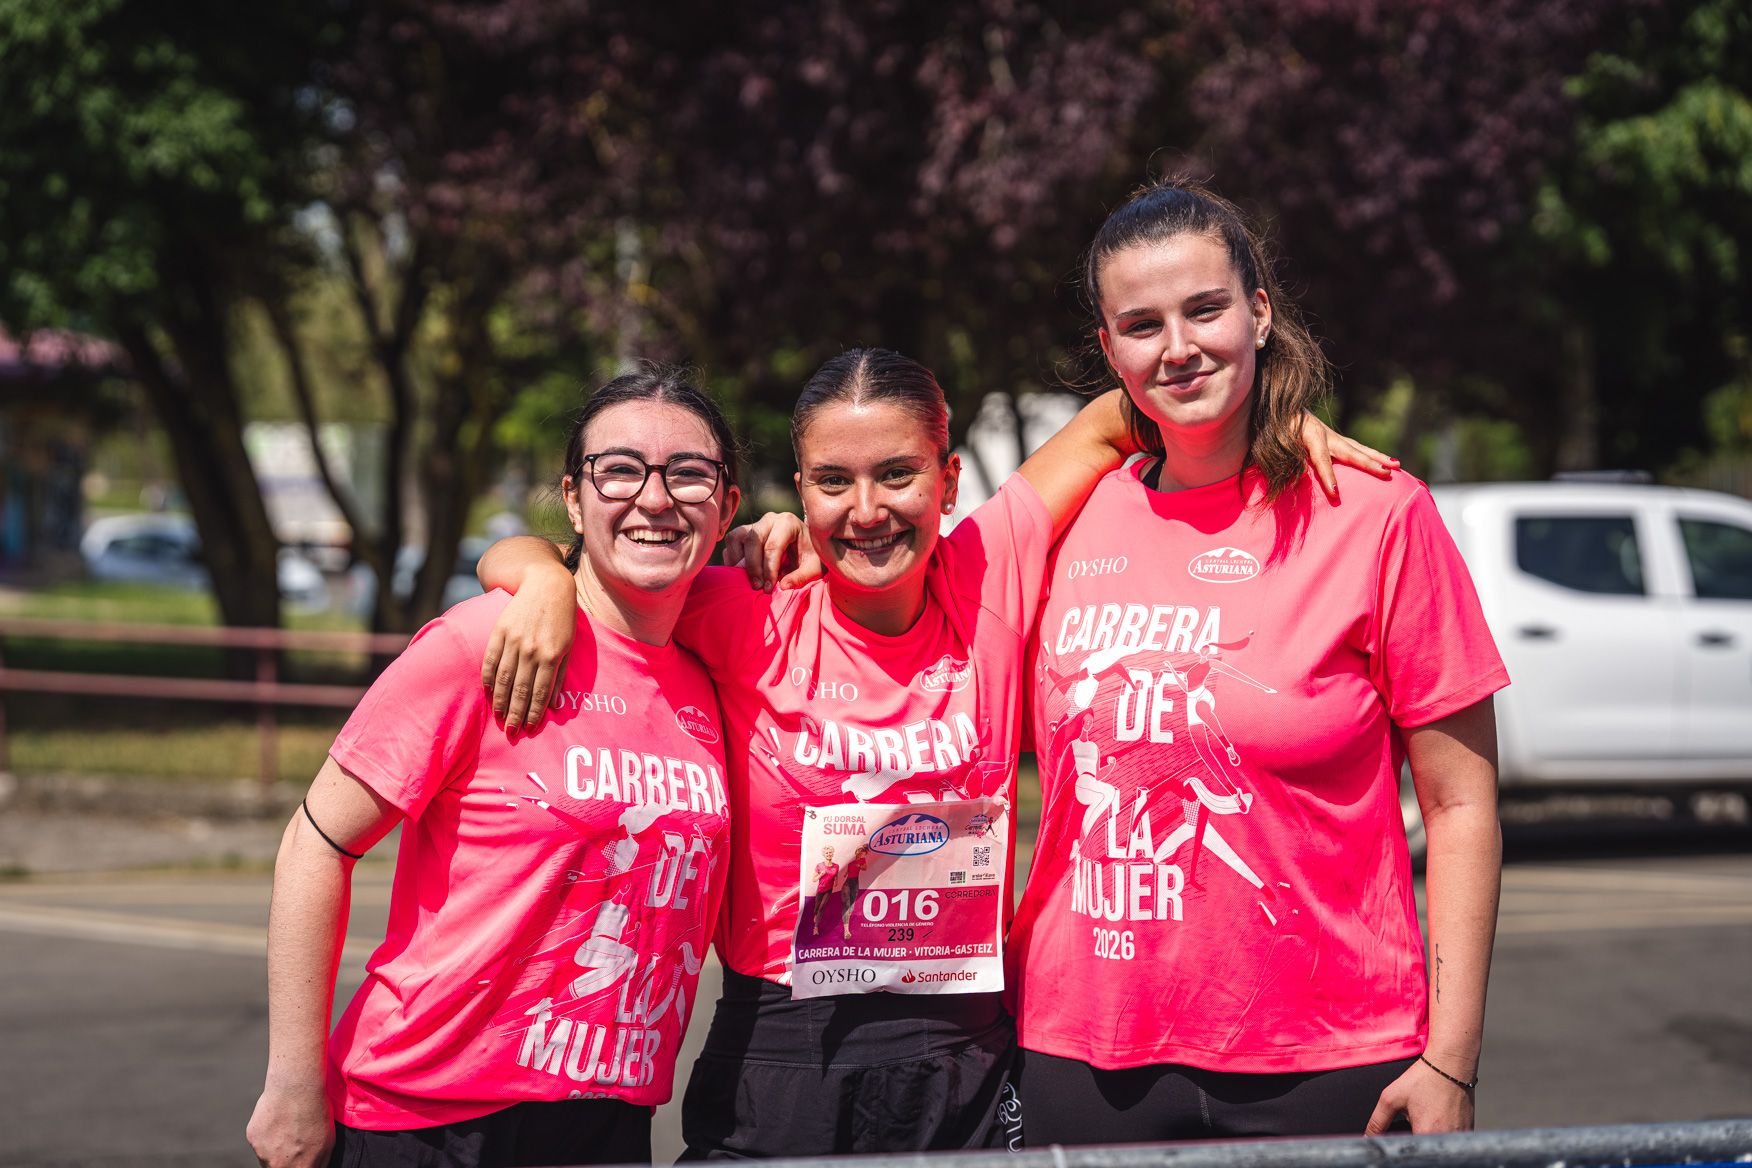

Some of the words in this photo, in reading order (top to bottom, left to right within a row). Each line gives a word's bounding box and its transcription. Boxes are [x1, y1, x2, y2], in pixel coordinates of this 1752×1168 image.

[1068, 556, 1128, 579] OYSHO
[1193, 560, 1253, 575] ASTURIANA
[1056, 603, 1221, 655] CARRERA
[1113, 667, 1187, 744] DE
[793, 712, 979, 773] CARRERA
[564, 745, 729, 815] CARRERA
[823, 823, 867, 836] SUMA
[834, 815, 866, 823] DORSAL
[1105, 787, 1154, 858] LA
[873, 831, 944, 848] ASTURIANA
[644, 830, 713, 910] DE
[1071, 853, 1185, 921] MUJER
[862, 889, 940, 922] 016
[798, 946, 840, 960] CARRERA
[842, 946, 856, 956] DE
[857, 946, 871, 957] LA
[873, 947, 907, 958] MUJER
[914, 943, 993, 957] VITORIA-GASTEIZ
[888, 928, 914, 942] 239
[1093, 927, 1135, 960] 2026
[614, 953, 660, 1023] LA
[812, 968, 877, 985] OYSHO
[917, 969, 978, 983] Santander
[516, 1009, 661, 1087] MUJER
